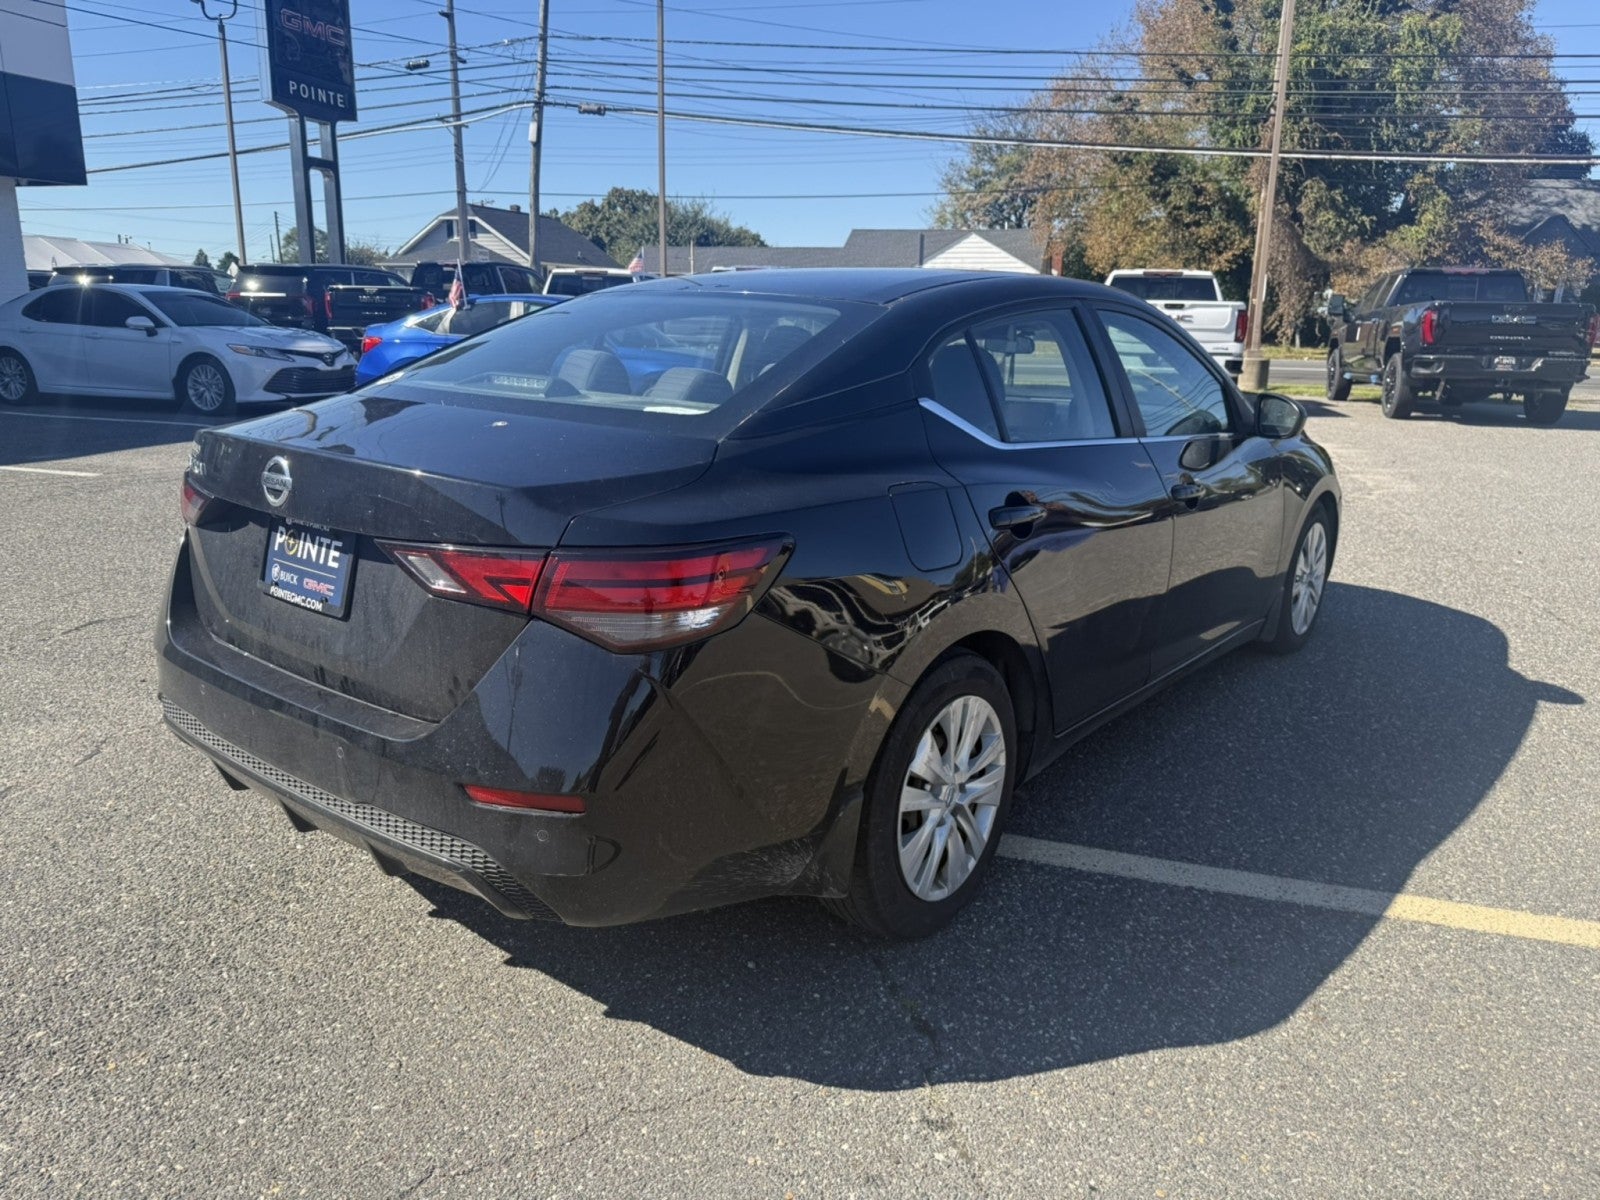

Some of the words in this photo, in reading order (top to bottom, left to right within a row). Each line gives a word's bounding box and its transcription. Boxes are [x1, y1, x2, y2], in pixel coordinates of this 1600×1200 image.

[280, 8, 346, 47] GMC
[288, 80, 345, 108] POINTE
[274, 525, 343, 569] POINTE
[280, 570, 299, 586] BUICK
[303, 577, 335, 597] GMC
[270, 585, 323, 612] POINTEGMC.COM
